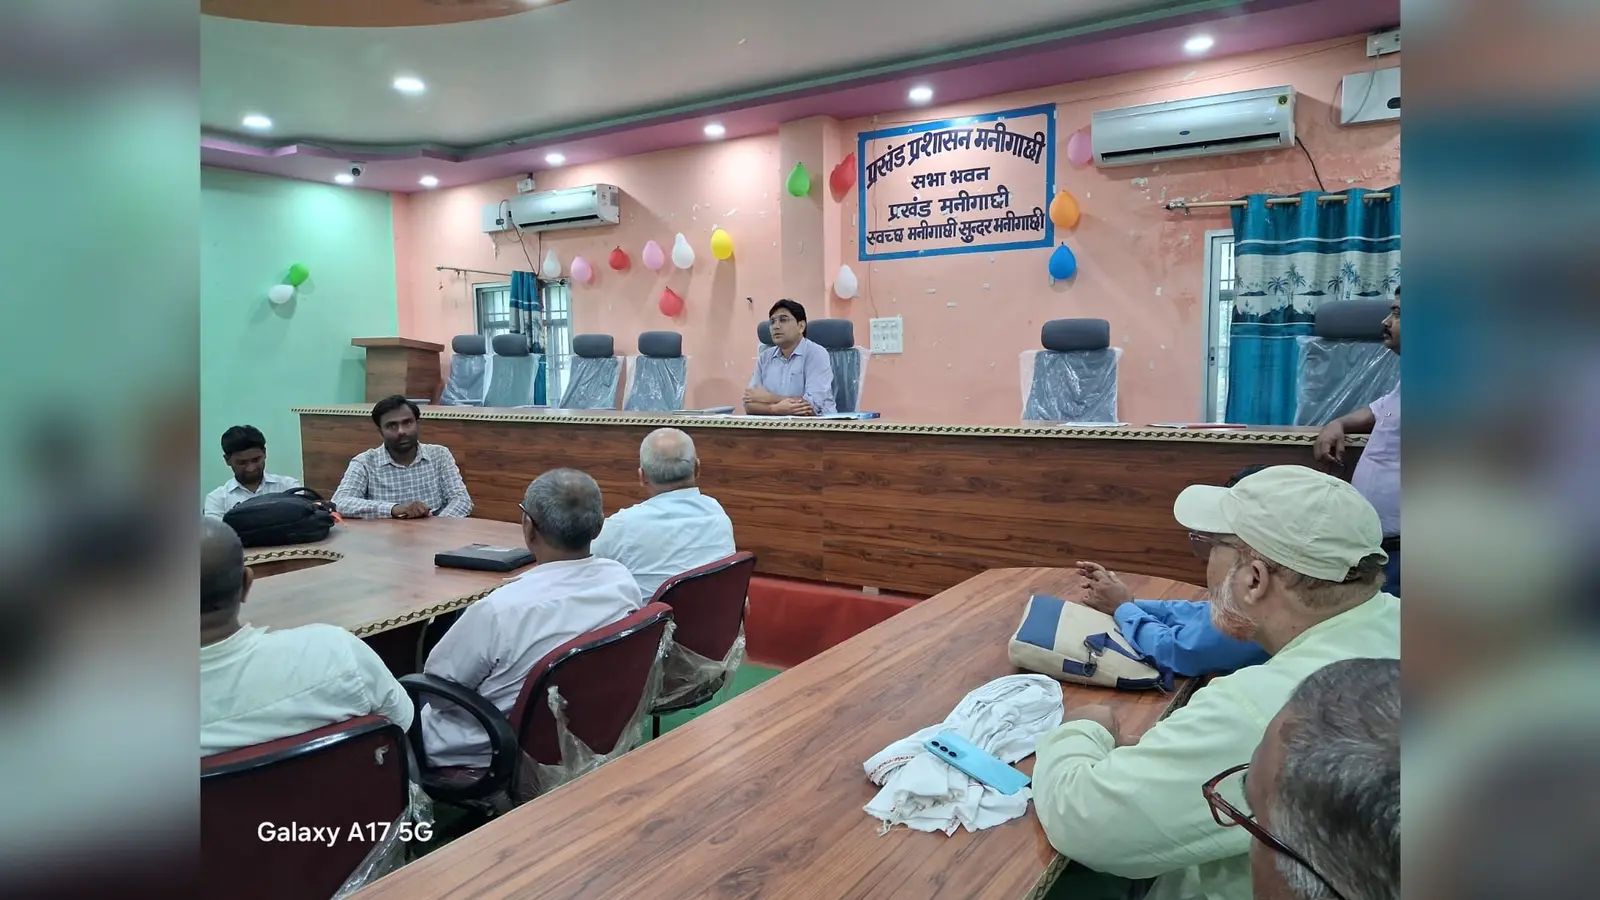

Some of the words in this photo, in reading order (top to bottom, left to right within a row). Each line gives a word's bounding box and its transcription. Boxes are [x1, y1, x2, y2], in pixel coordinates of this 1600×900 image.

[866, 144, 906, 189] प्रखंड
[907, 128, 973, 166] प्रशासन
[974, 122, 1046, 164] मनीगाछी
[911, 172, 946, 189] सभा
[950, 166, 991, 184] भवन
[888, 196, 933, 221] प्रखंड
[867, 228, 904, 245] स्वच्छ
[907, 217, 958, 240] मनीगाछी
[959, 219, 993, 243] सुन्दर
[993, 206, 1045, 232] मनीगाछी
